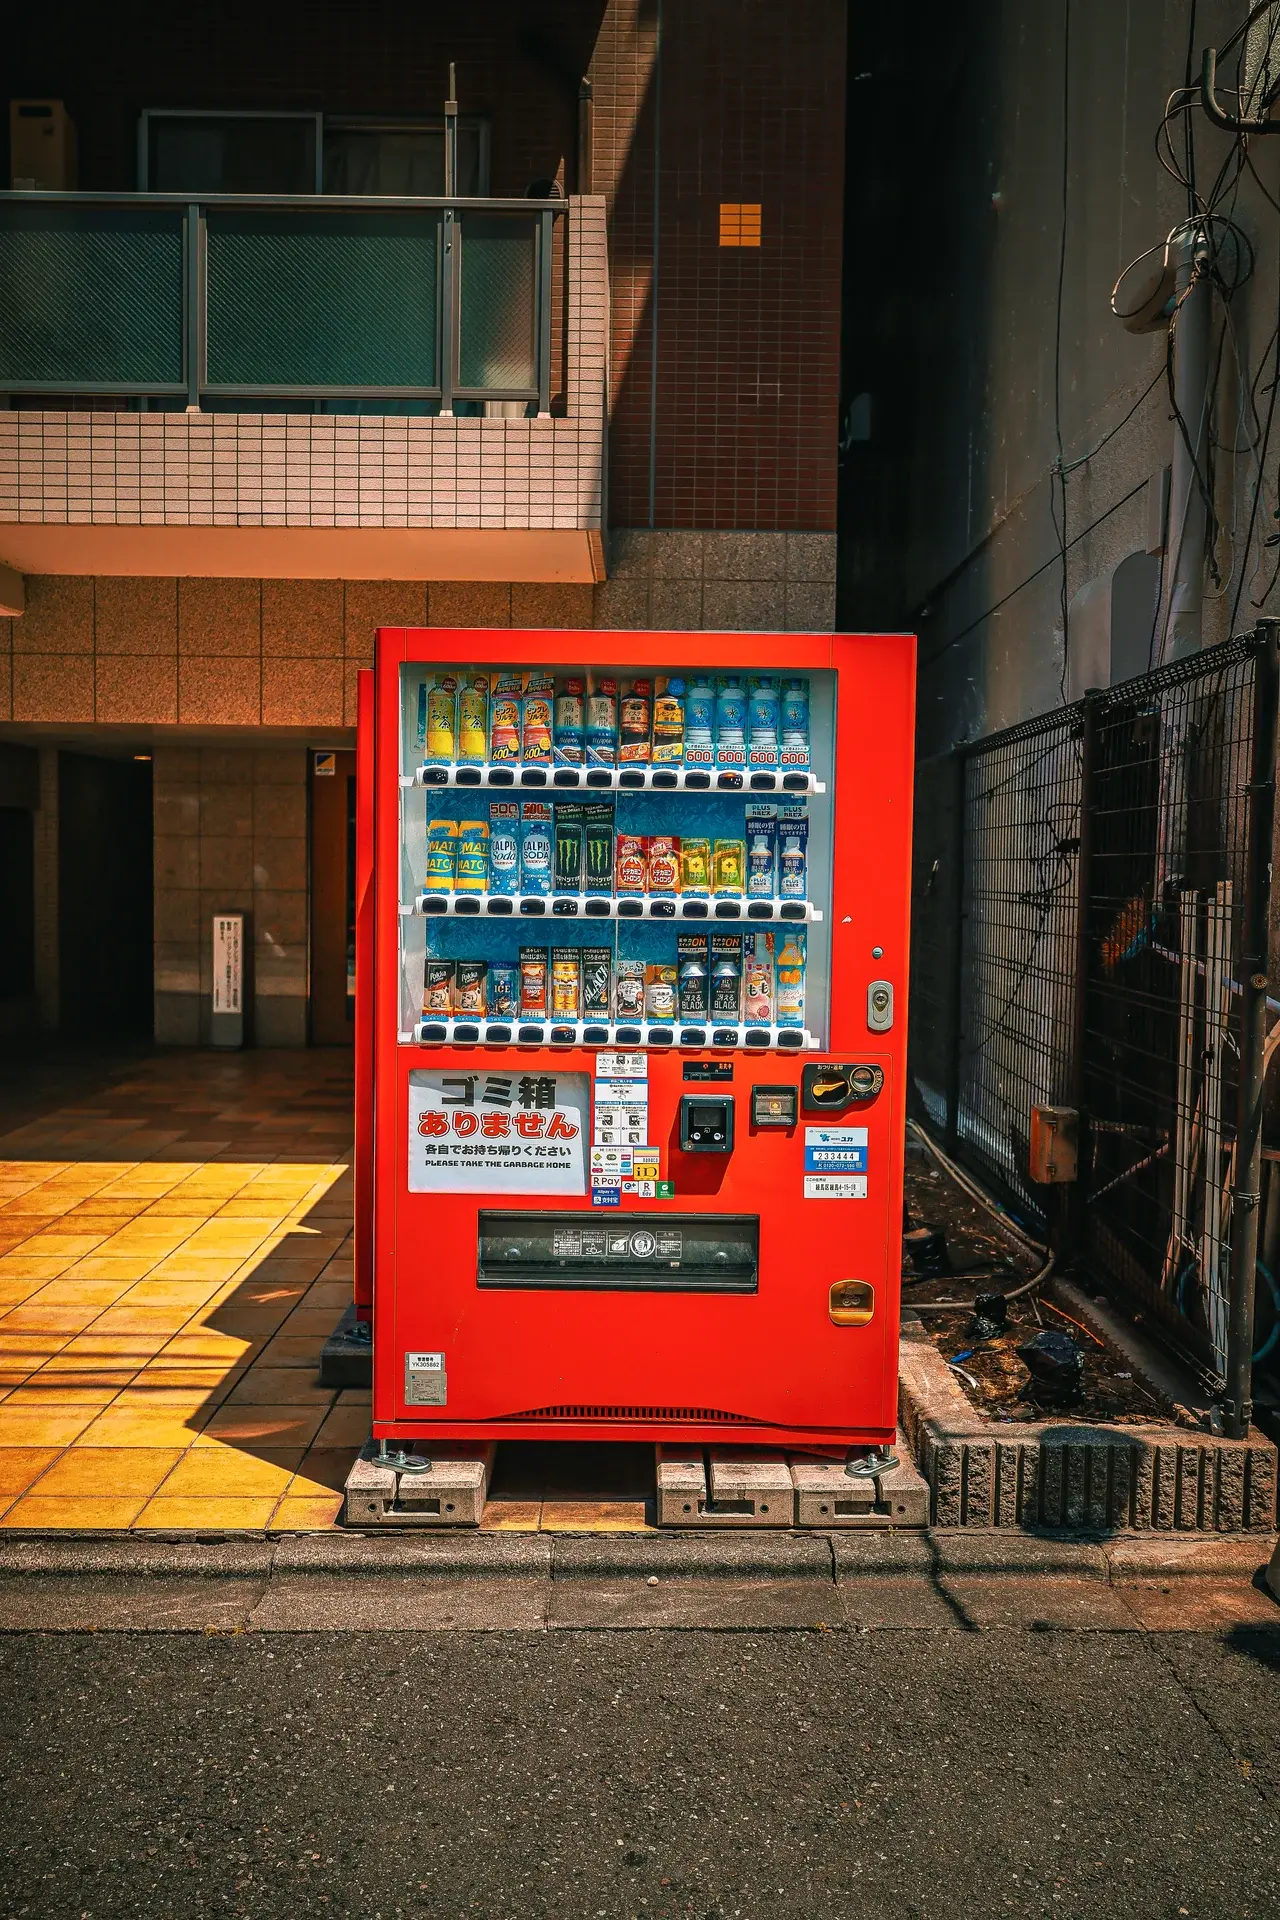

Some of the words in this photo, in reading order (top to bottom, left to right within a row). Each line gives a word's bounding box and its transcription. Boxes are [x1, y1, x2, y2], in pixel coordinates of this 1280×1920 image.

[493, 841, 516, 850] CALPIS
[524, 841, 549, 850] CALPIS
[493, 851, 516, 860] Soda
[692, 938, 706, 947] ON
[726, 938, 739, 947] ON
[682, 1001, 704, 1009] BLACK
[714, 1001, 736, 1009] BLACK
[441, 1076, 557, 1110] ゴミ箱
[418, 1110, 579, 1140] ありません
[425, 1144, 571, 1157] 各自でお持ち帰りください
[637, 1167, 657, 1177] iD
[602, 1178, 619, 1186] Pay
